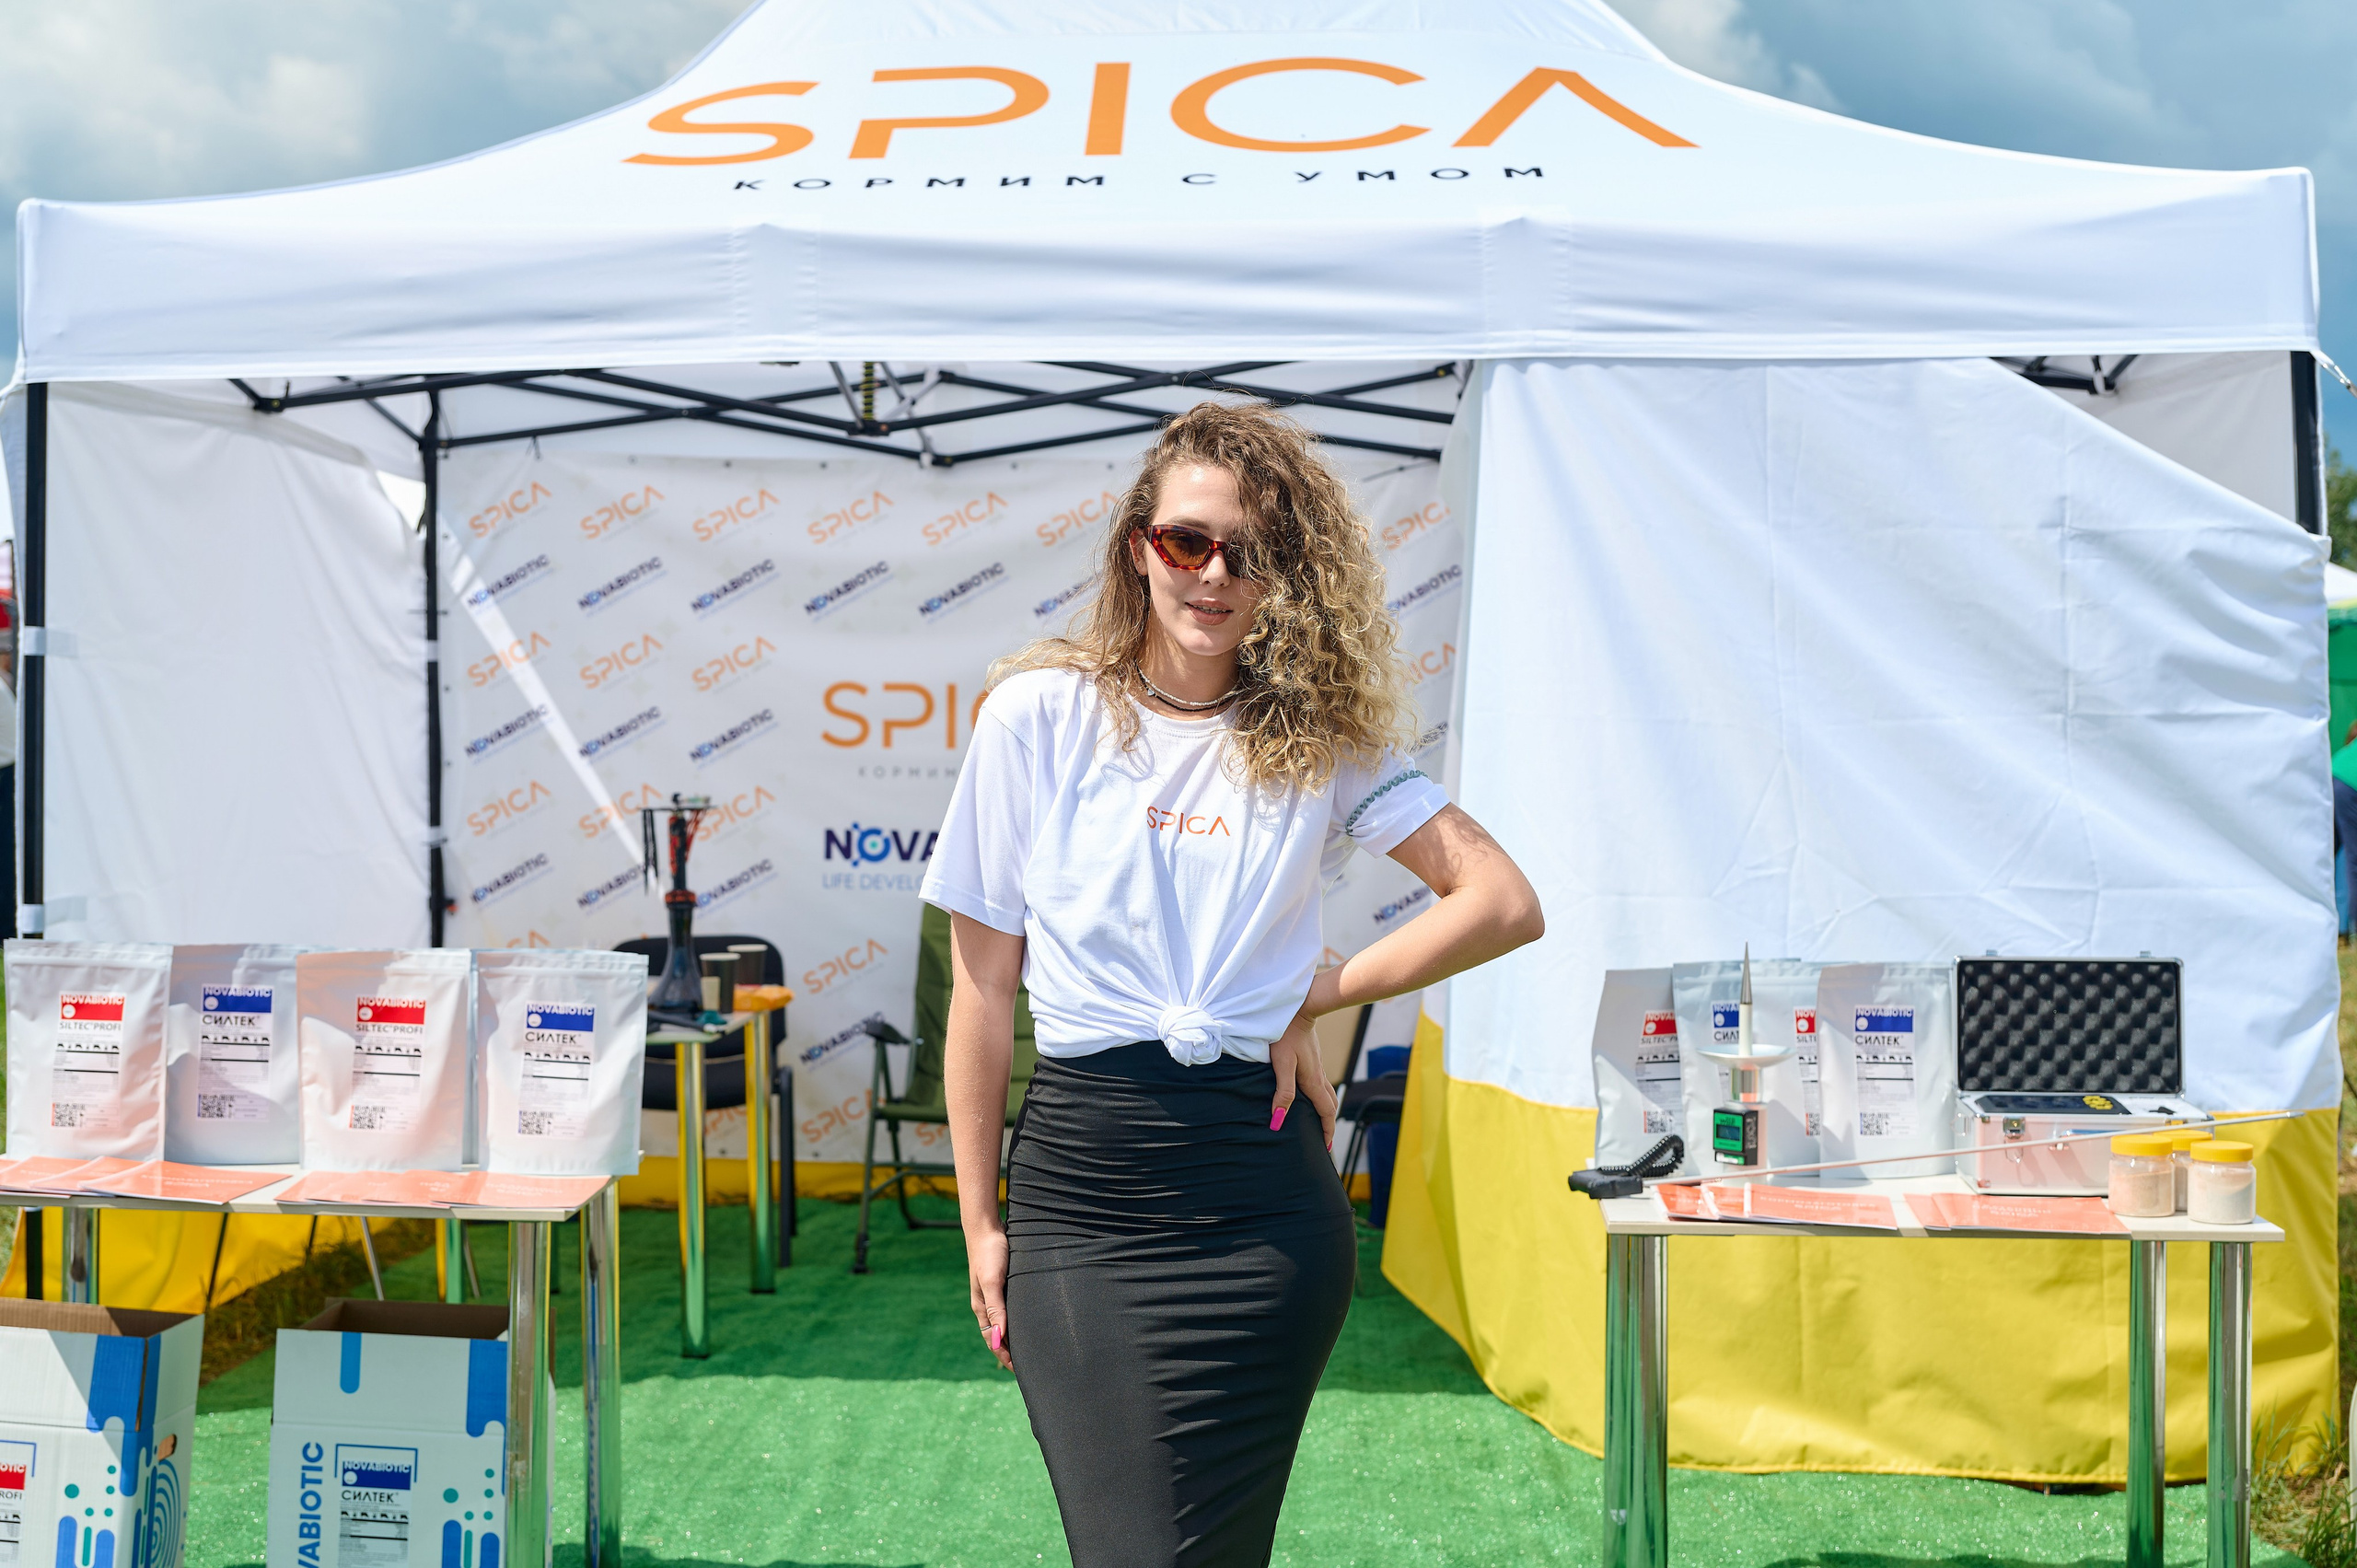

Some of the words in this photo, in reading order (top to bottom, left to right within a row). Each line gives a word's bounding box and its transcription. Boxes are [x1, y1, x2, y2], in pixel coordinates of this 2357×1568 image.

[621, 56, 1701, 167] SPICA
[734, 175, 1105, 191] КОРМИМ
[1294, 167, 1544, 183] УМОМ
[469, 481, 552, 538] SPICA
[579, 484, 666, 540] SPICA
[691, 488, 780, 542] SPICA
[807, 490, 894, 545] SPICA
[921, 491, 1008, 546] SPICA
[577, 556, 663, 610] NOVABIOTIC
[691, 558, 776, 612] NOVABIOTIC
[804, 561, 890, 615] NOVABIOTIC
[918, 563, 1004, 617] NOVABIOTIC
[467, 631, 552, 688] SPICA
[579, 633, 664, 690] SPICA
[691, 635, 778, 692] SPICA
[578, 706, 661, 758] NOVABIOTIC
[690, 708, 774, 761] NOVABIOTIC
[820, 679, 988, 750] SPI
[466, 779, 552, 837] SPICA
[578, 783, 664, 839] SPICA
[1146, 805, 1232, 838] SPICA
[803, 938, 889, 995] SPICA
